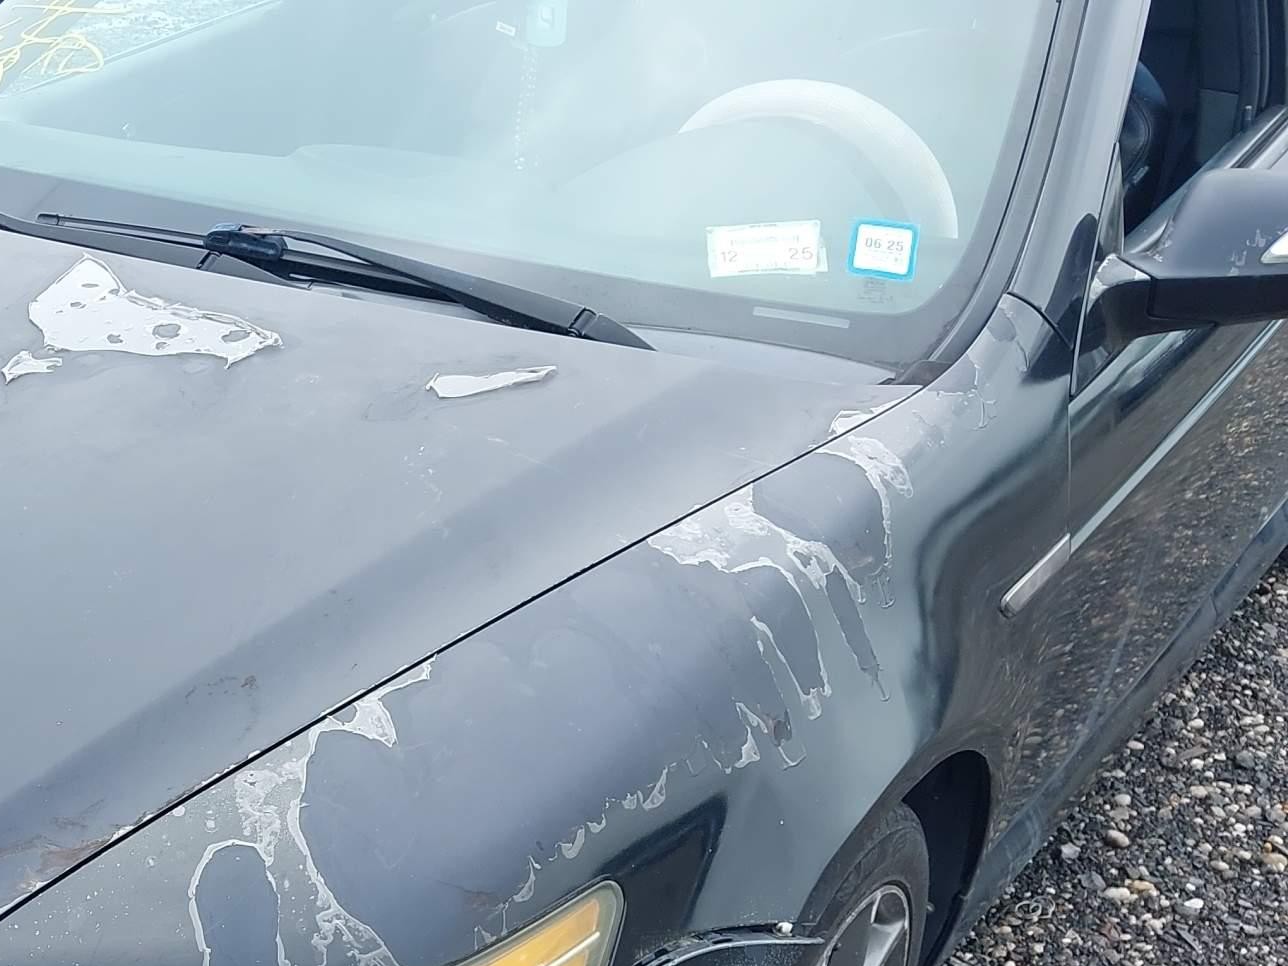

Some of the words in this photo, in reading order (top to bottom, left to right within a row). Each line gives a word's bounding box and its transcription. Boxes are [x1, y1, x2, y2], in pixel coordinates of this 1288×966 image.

[864, 236, 883, 249] 06
[886, 240, 904, 252] 25
[720, 250, 738, 263] 12
[788, 246, 814, 261] 25
